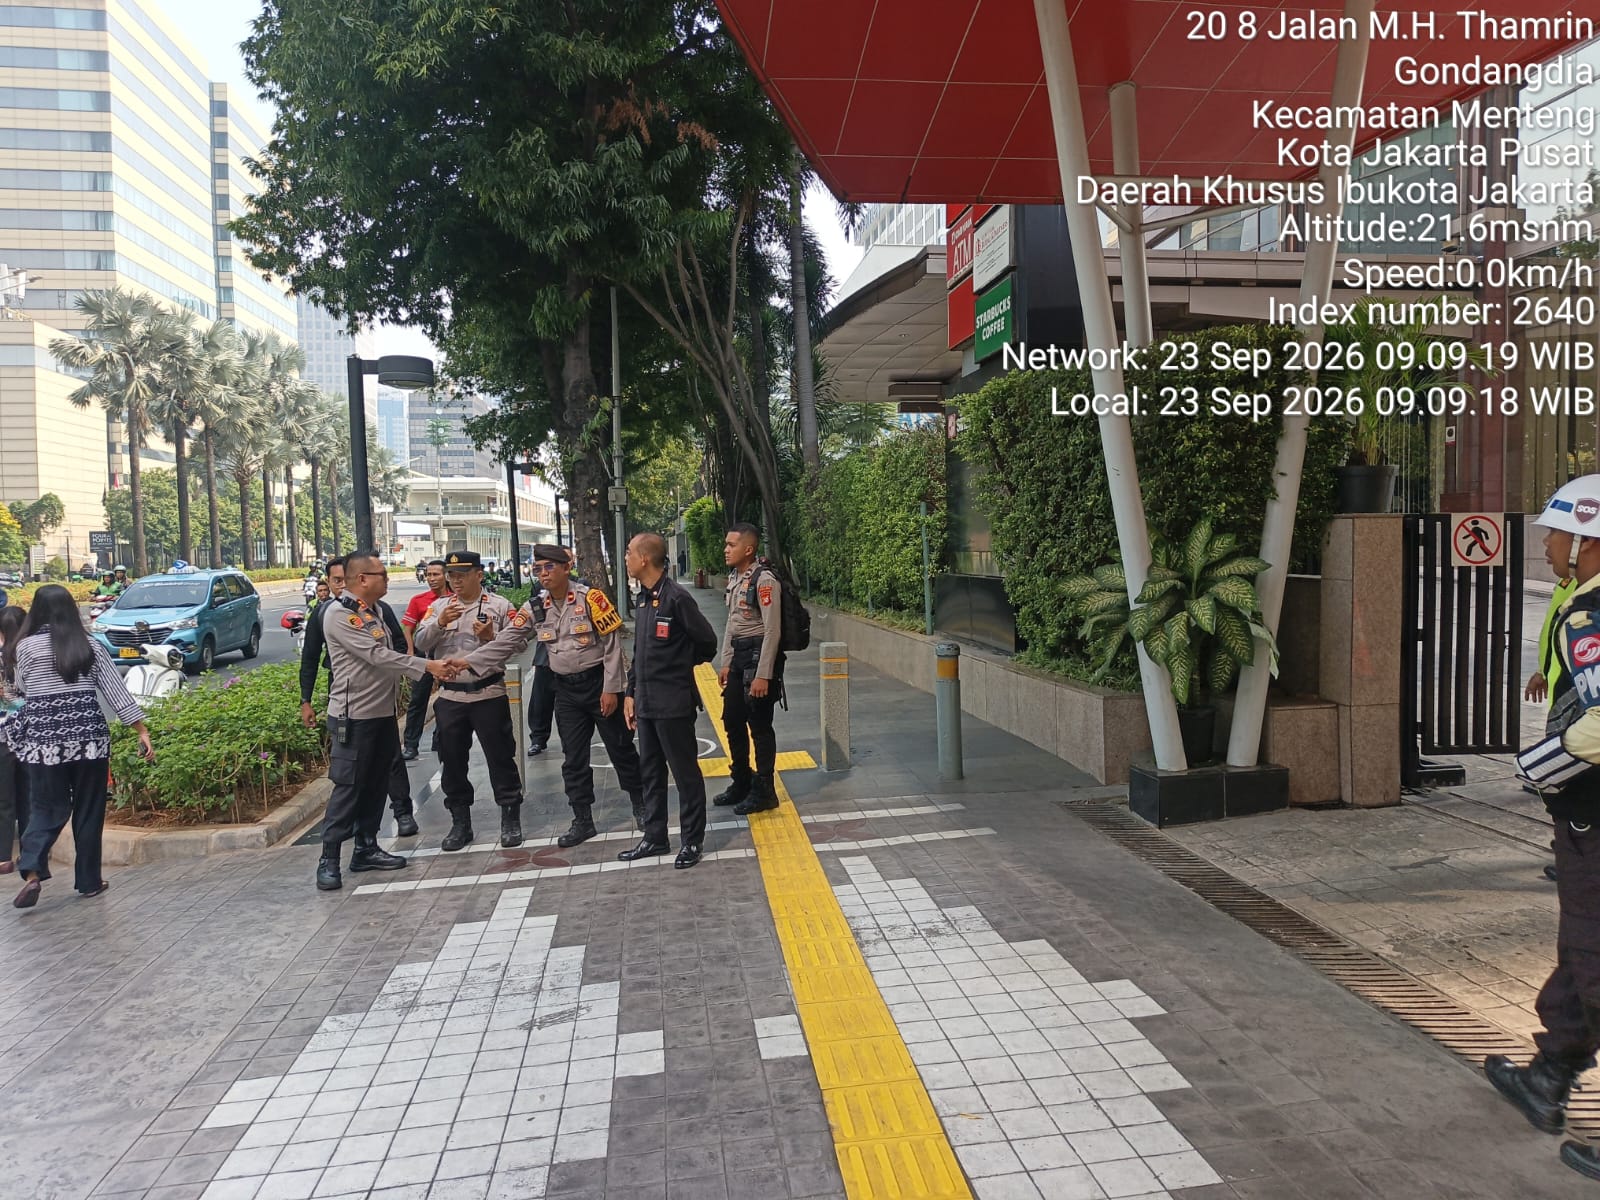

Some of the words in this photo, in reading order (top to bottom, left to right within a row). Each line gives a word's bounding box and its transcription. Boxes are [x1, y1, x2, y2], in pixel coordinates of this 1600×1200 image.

[953, 232, 972, 276] ATM
[975, 295, 1011, 329] STARBUCKS
[982, 316, 1005, 341] COFFEE
[1576, 504, 1598, 515] SOS
